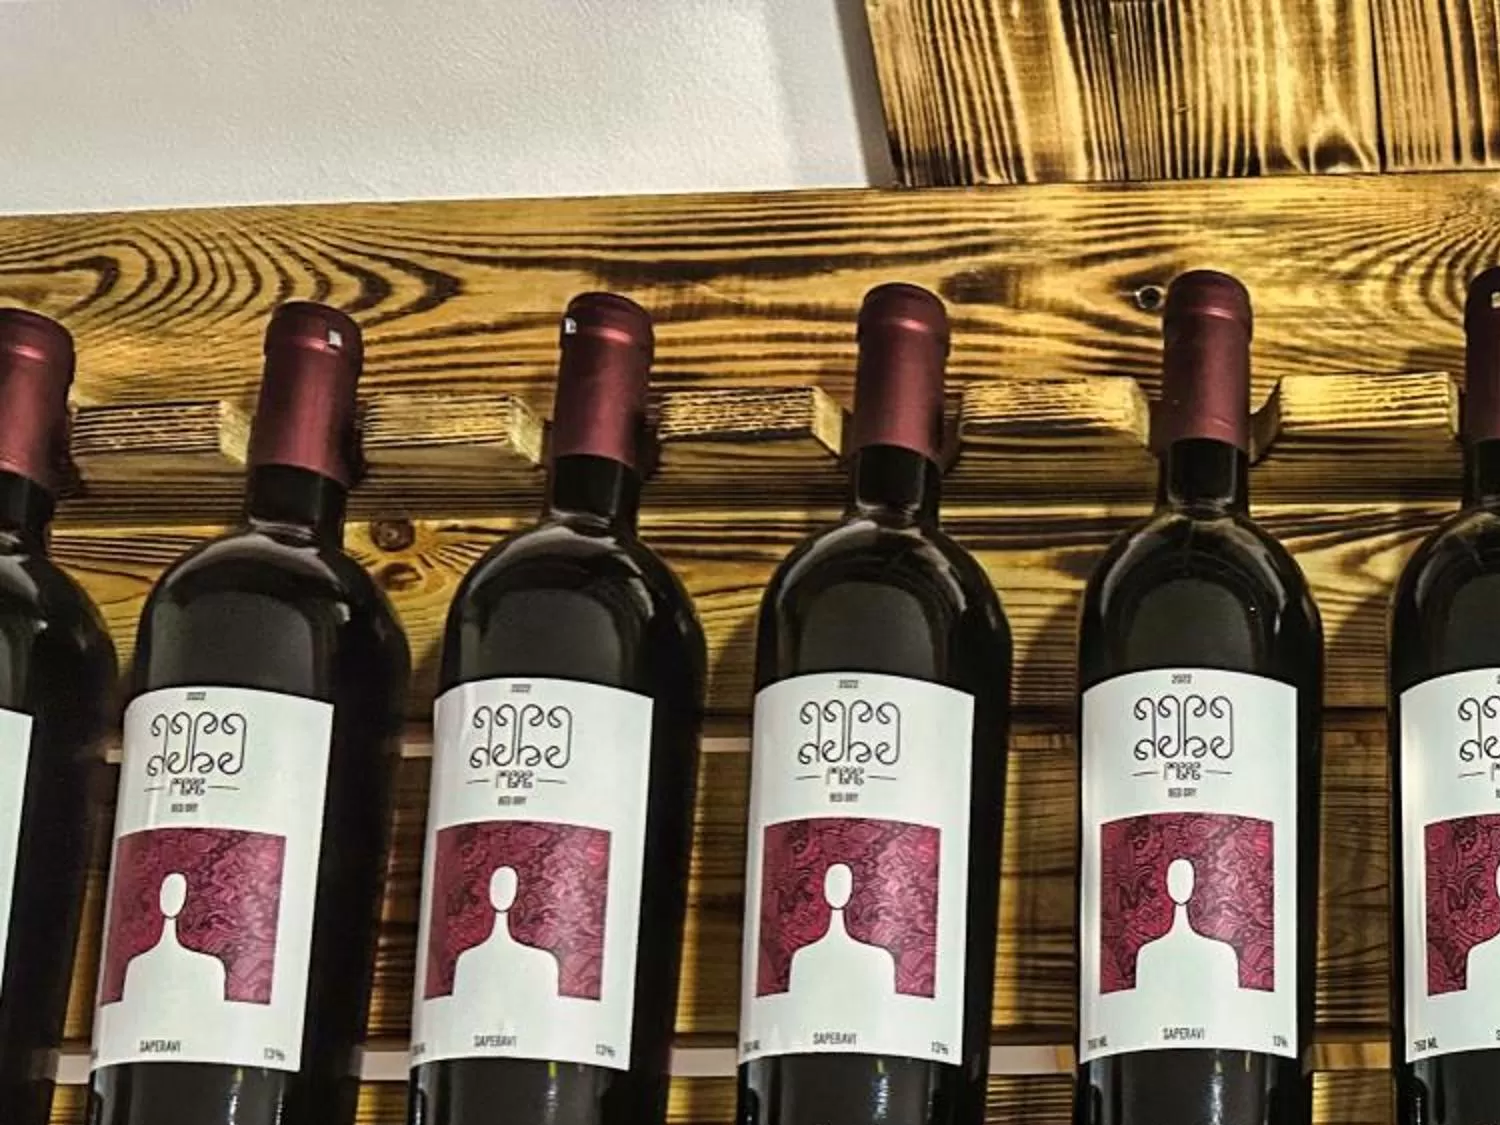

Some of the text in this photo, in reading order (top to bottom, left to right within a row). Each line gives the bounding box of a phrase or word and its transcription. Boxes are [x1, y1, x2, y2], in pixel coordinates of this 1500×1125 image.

[813, 1032, 857, 1045] SAPERAVI
[1163, 1028, 1205, 1040] SAPERAVI
[140, 1040, 181, 1053] SAPERAVI
[474, 1035, 517, 1048] SAPERAVI
